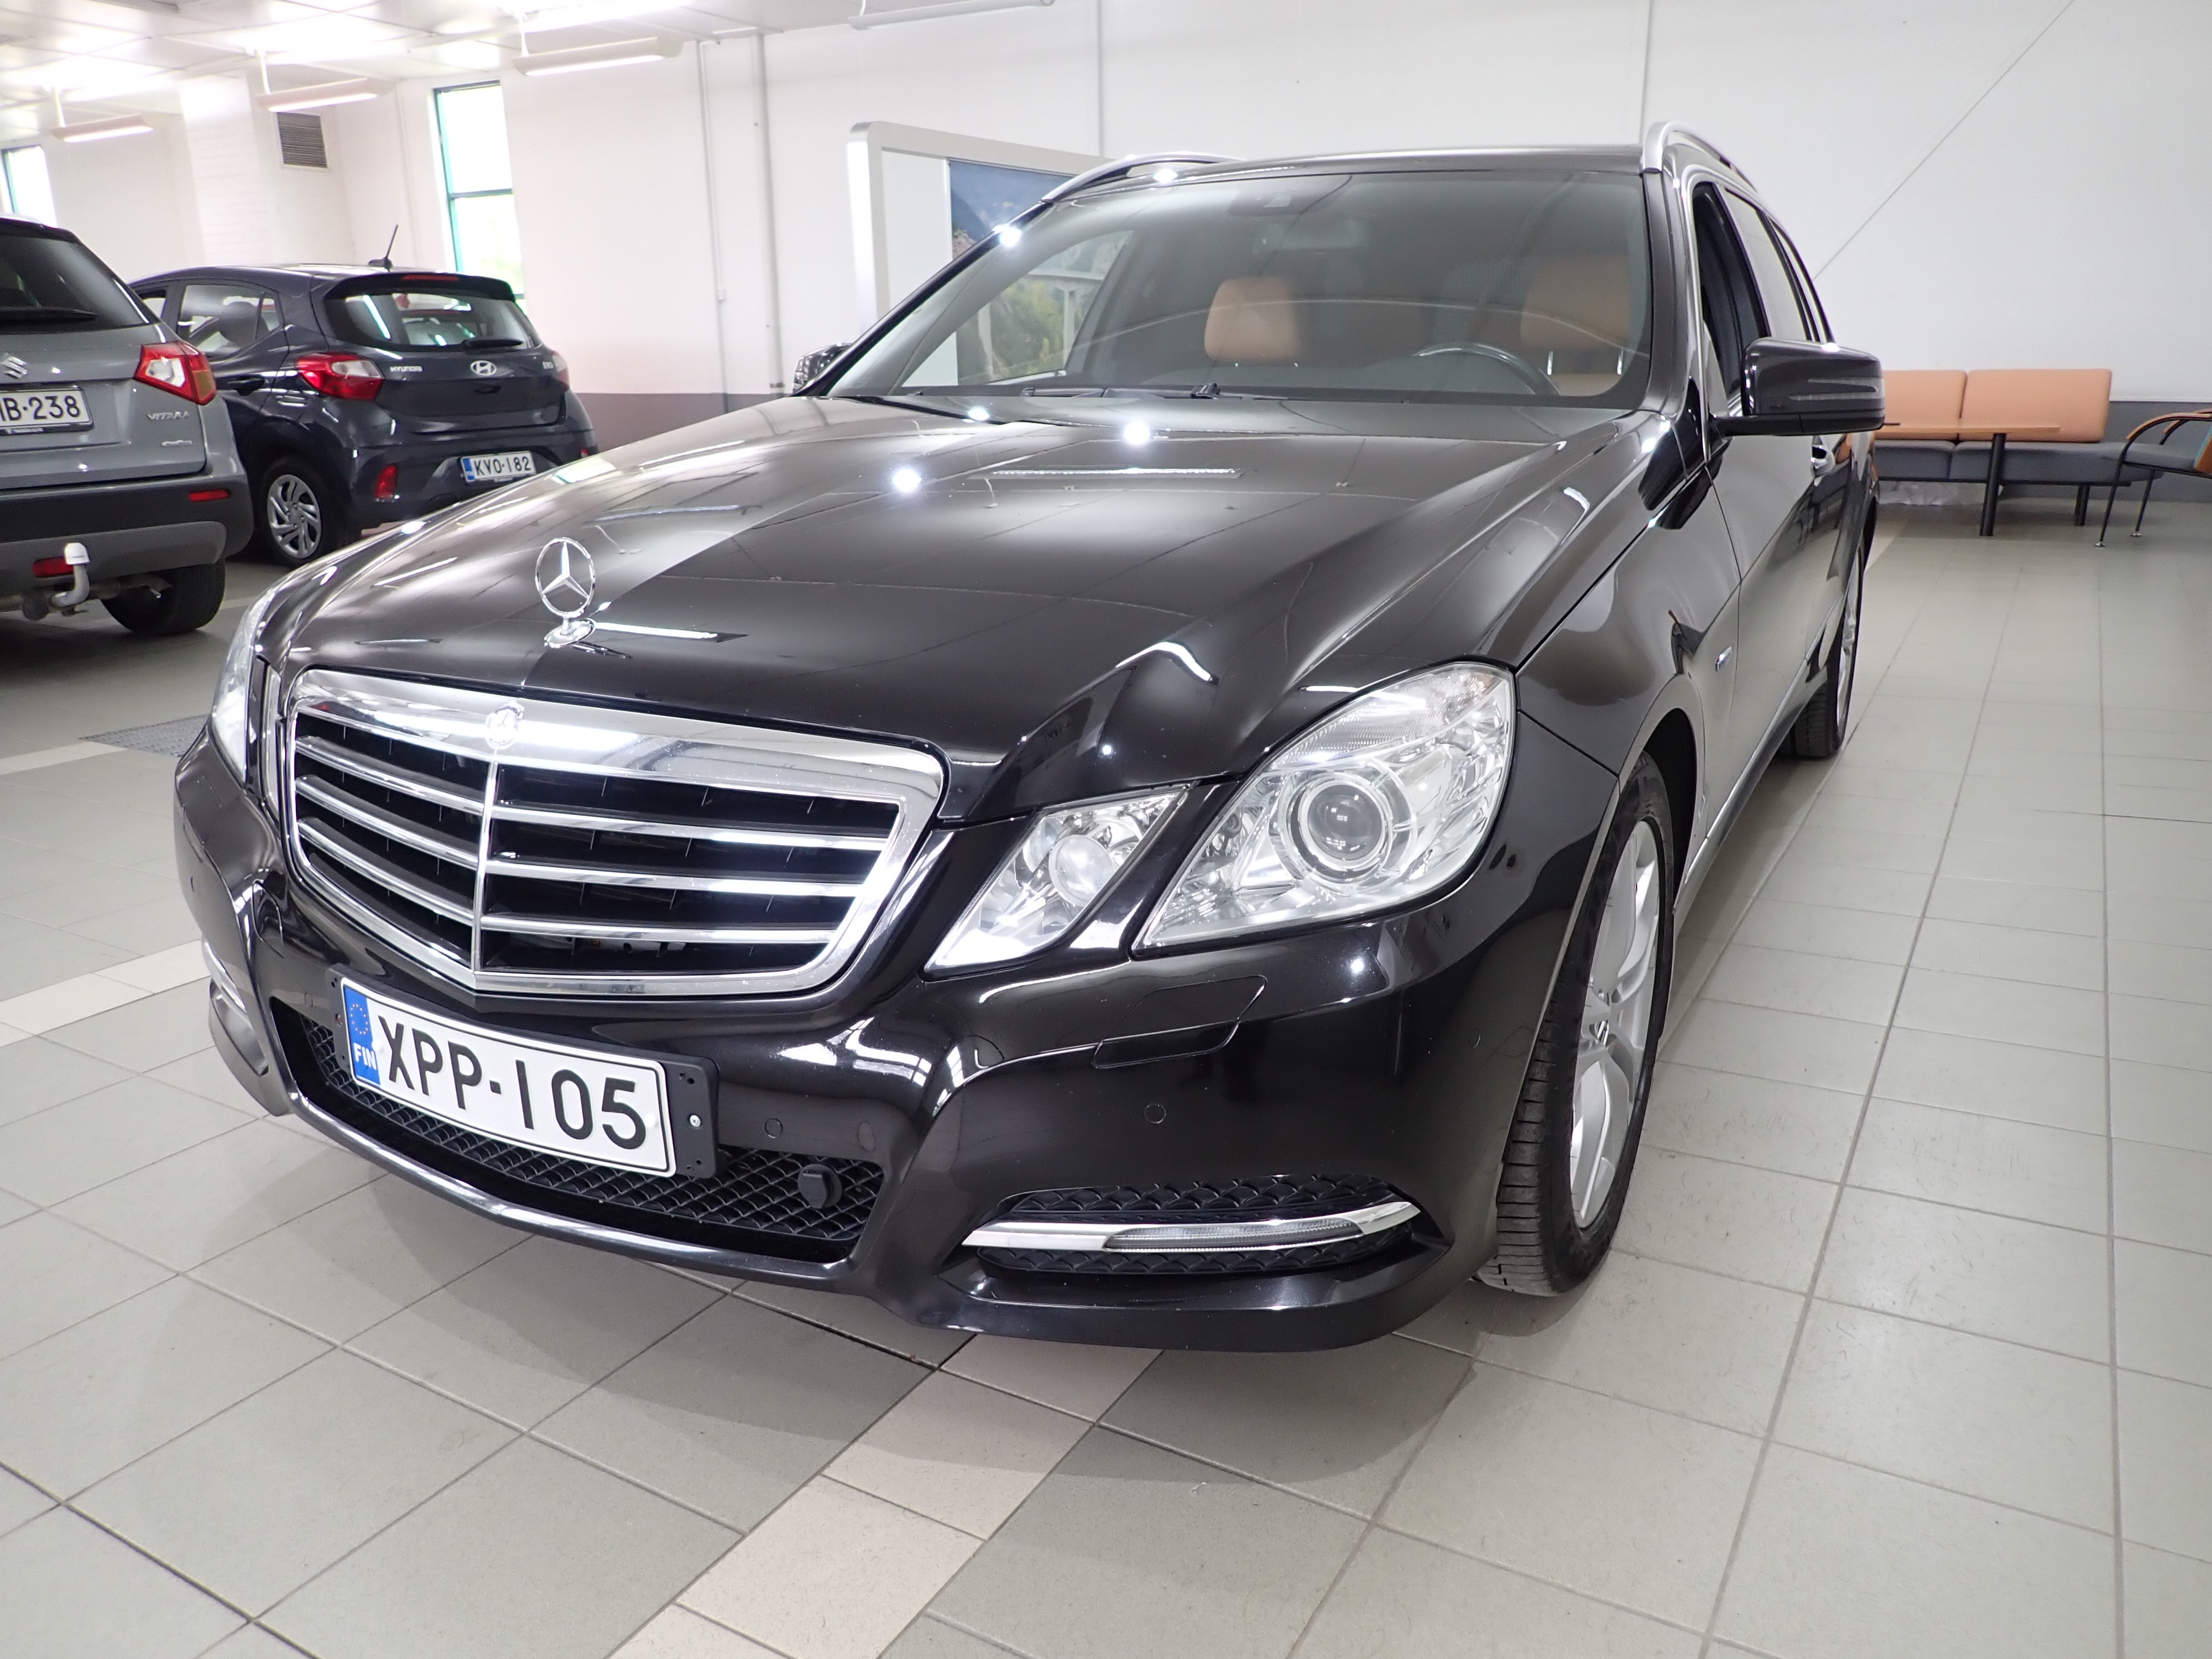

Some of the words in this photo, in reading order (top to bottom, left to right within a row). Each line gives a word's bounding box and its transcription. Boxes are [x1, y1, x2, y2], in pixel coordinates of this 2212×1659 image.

[146, 411, 190, 420] VITARA
[474, 456, 531, 476] KVO-182
[353, 1042, 377, 1071] FIN
[378, 1015, 646, 1150] XPP-105
